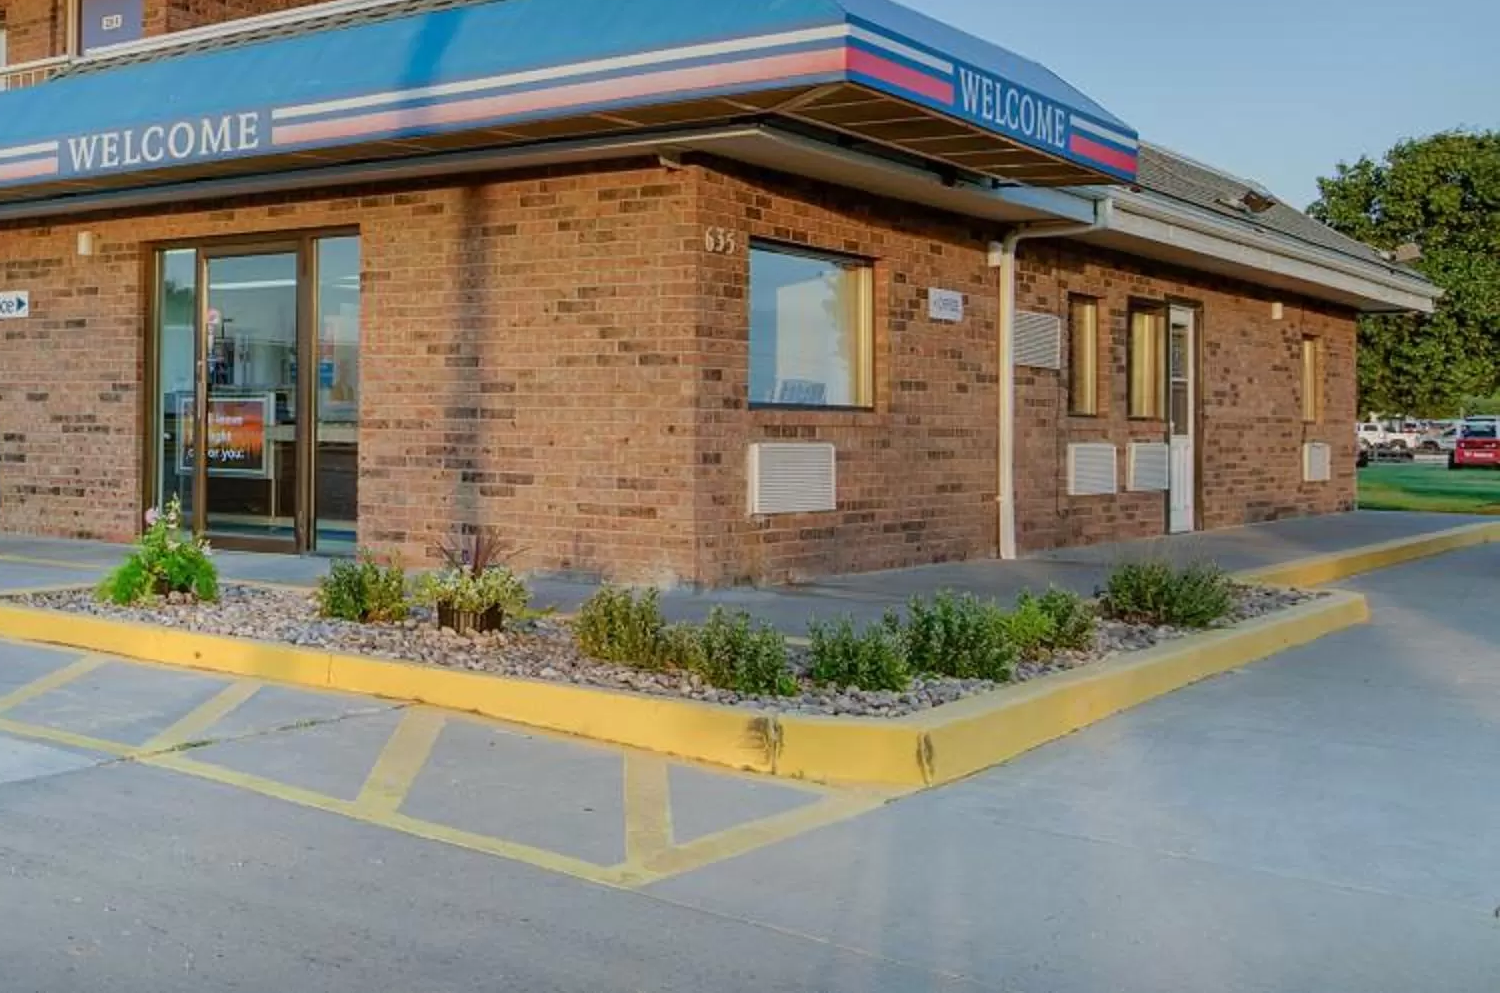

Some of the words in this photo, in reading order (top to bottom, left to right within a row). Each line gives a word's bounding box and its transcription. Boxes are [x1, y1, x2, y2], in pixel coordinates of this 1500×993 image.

[959, 67, 1066, 148] WELCOME
[68, 112, 259, 171] WELCOME
[705, 226, 736, 255] 635
